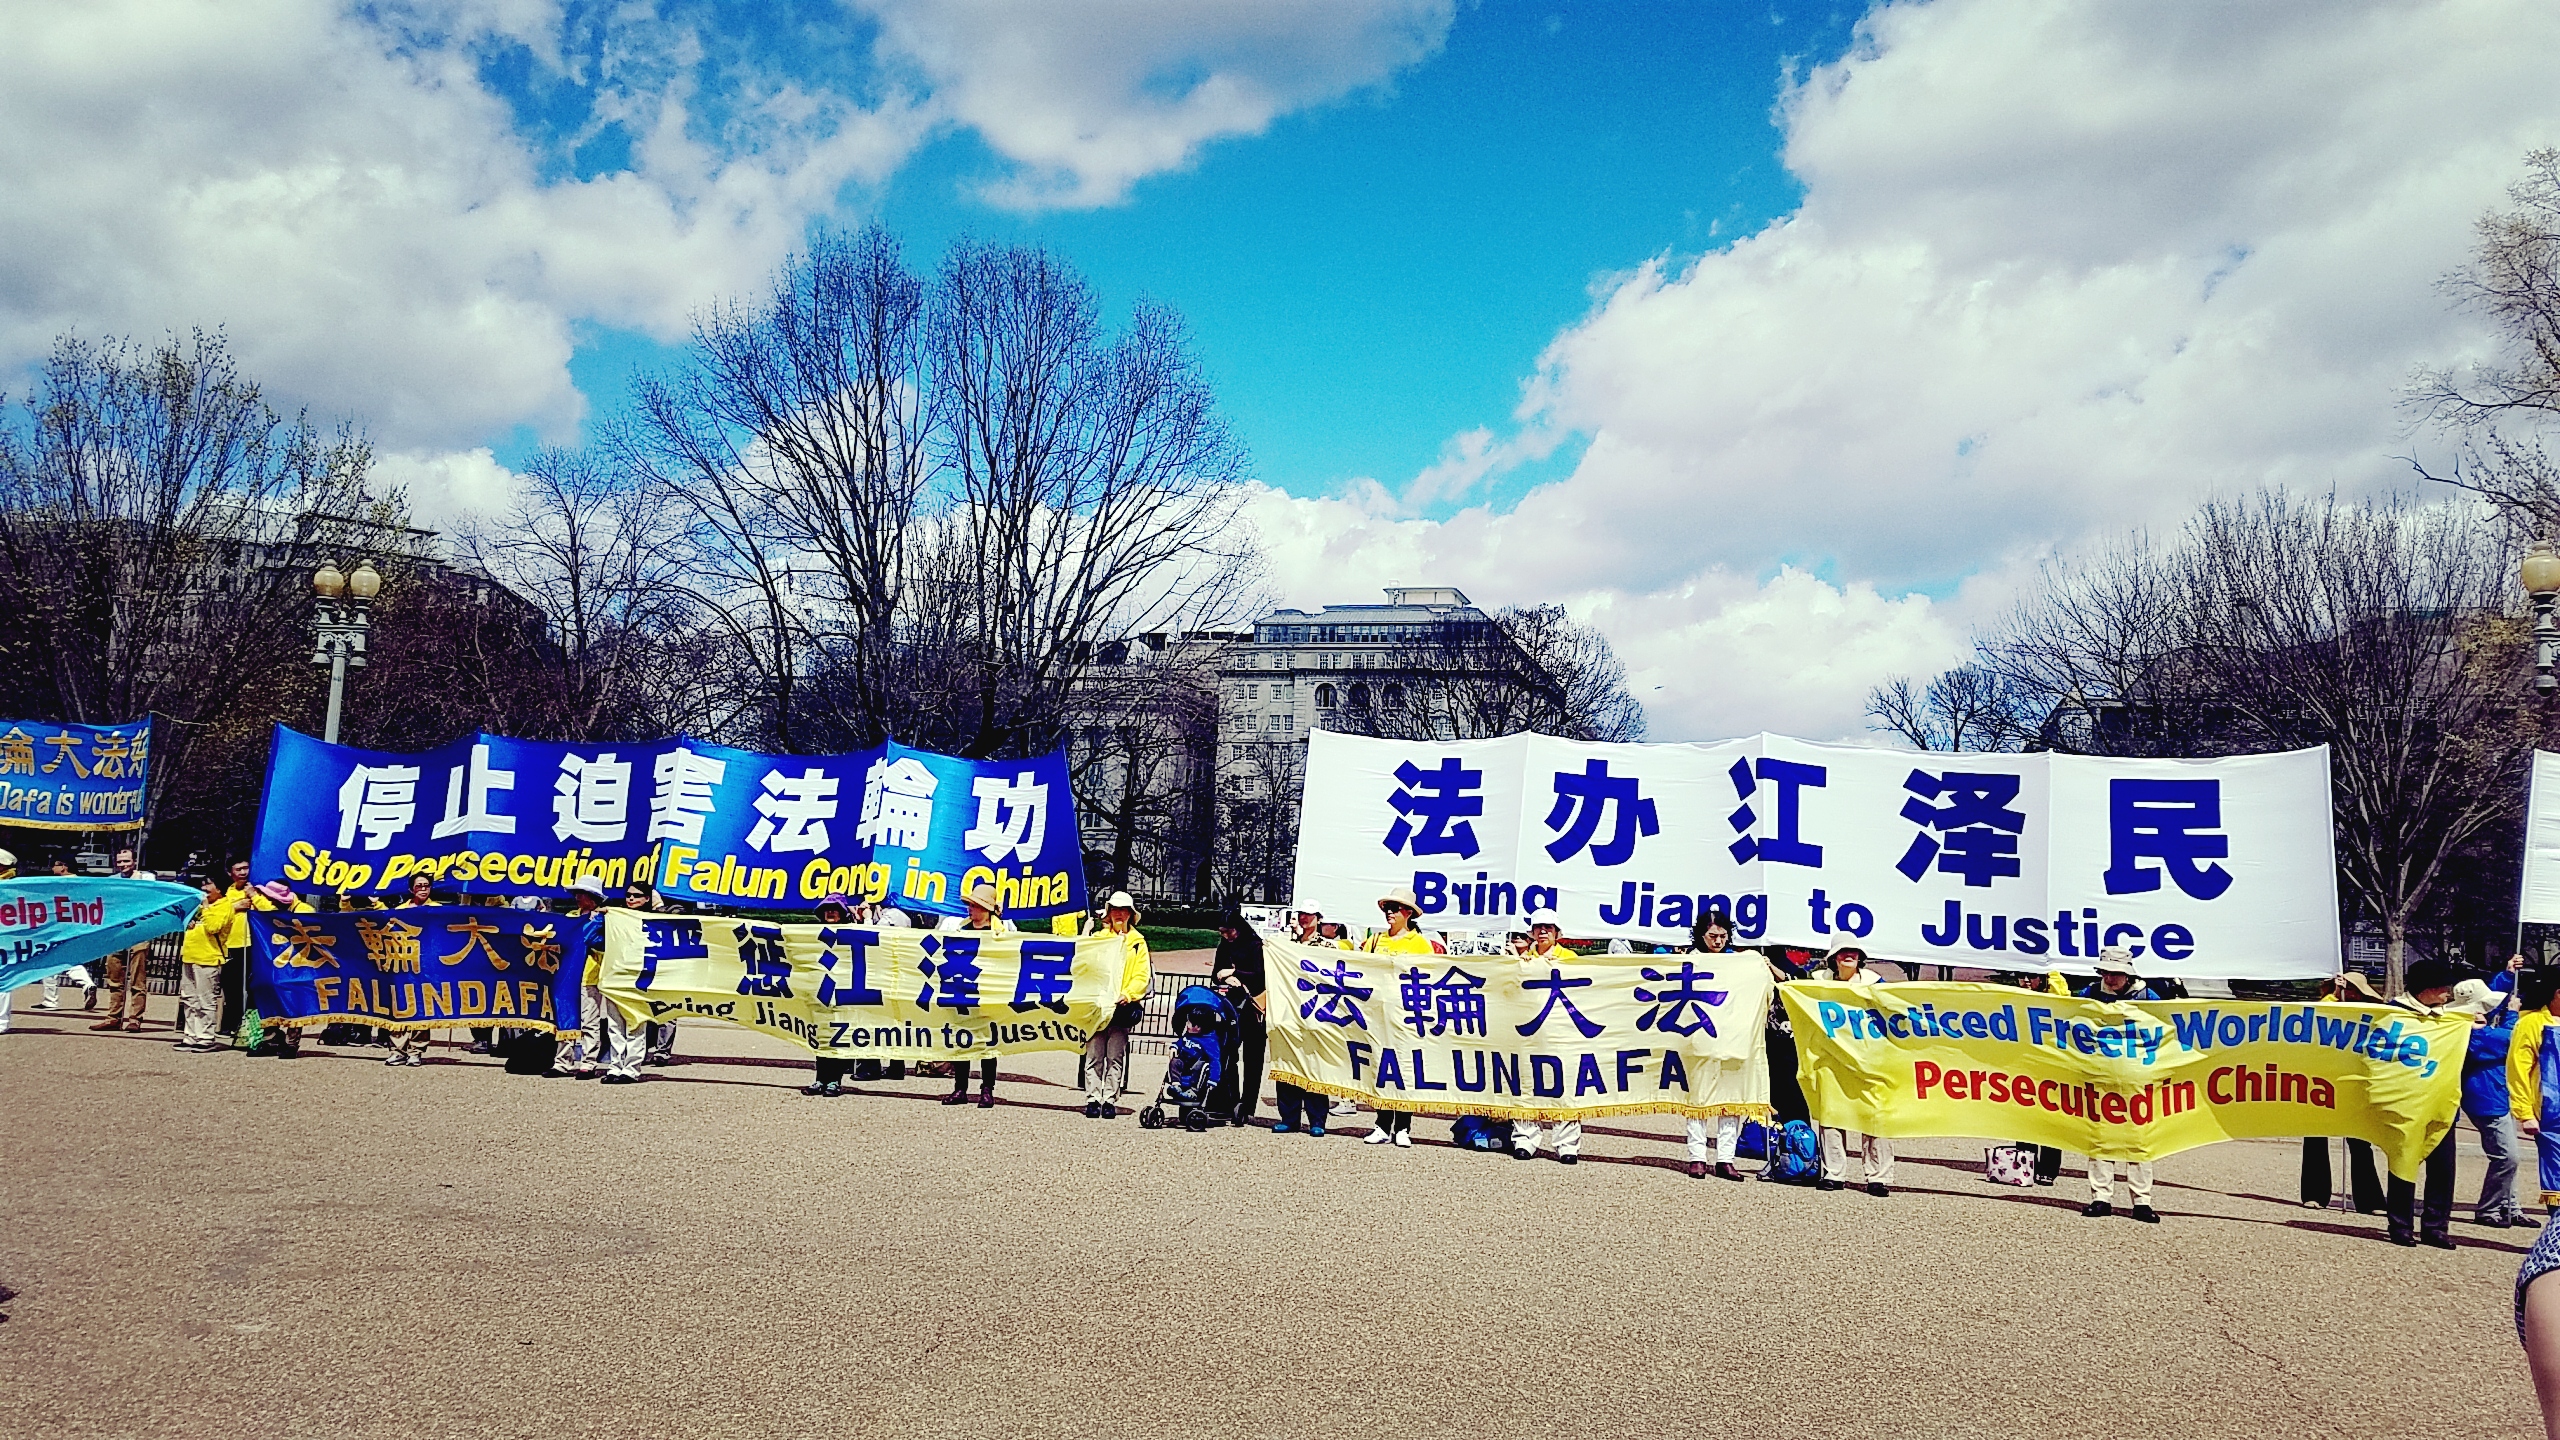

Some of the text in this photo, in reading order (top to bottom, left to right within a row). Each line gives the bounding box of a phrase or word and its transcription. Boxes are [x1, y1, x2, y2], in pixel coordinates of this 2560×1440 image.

[56, 784, 74, 815] is
[79, 786, 143, 819] wonderfu
[335, 744, 1049, 863] 停止迫害法輪功
[1383, 756, 2234, 900] 法办江泽民
[284, 840, 372, 895] Stop
[375, 847, 625, 890] Persecution
[633, 842, 660, 886] of
[663, 845, 788, 900] Falun
[799, 858, 891, 902] Gong
[902, 857, 947, 903] in
[54, 896, 104, 926] End
[1413, 871, 2195, 961] Bring Jiang to Justice
[271, 916, 561, 975] 法輪大法
[635, 918, 1076, 1015] 严惩江泽民
[314, 976, 555, 1022] FALUNDAFA
[755, 1001, 820, 1050] Jiang
[829, 1020, 932, 1048] Zemin
[940, 1022, 974, 1049] to
[1297, 958, 1729, 1040] 法輪大法
[1346, 1041, 1690, 1099] FALUNDAFA
[1817, 1000, 2438, 1079] Practiced Freely Worldwide,
[1914, 1060, 2336, 1126] Persecuted in China
